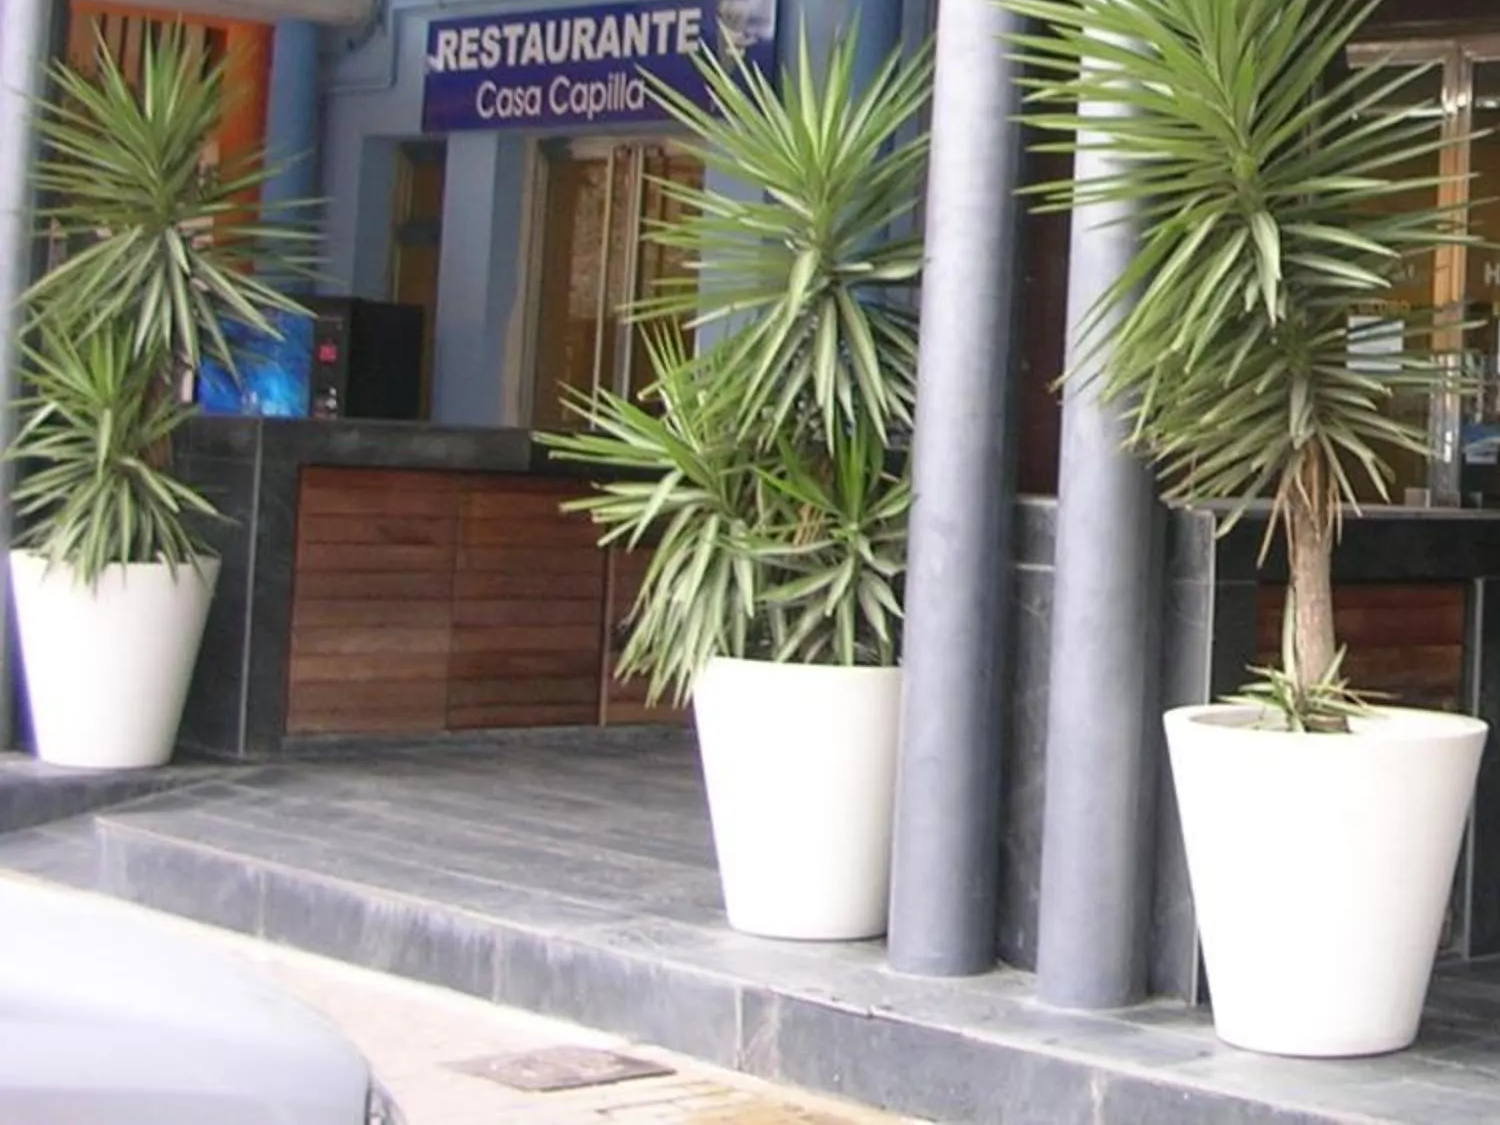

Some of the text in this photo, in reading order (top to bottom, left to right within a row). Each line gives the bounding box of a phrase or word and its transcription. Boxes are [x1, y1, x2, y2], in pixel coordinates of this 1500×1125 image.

[436, 6, 702, 72] RESTAURANTE
[476, 72, 646, 120] Casa Capilla
